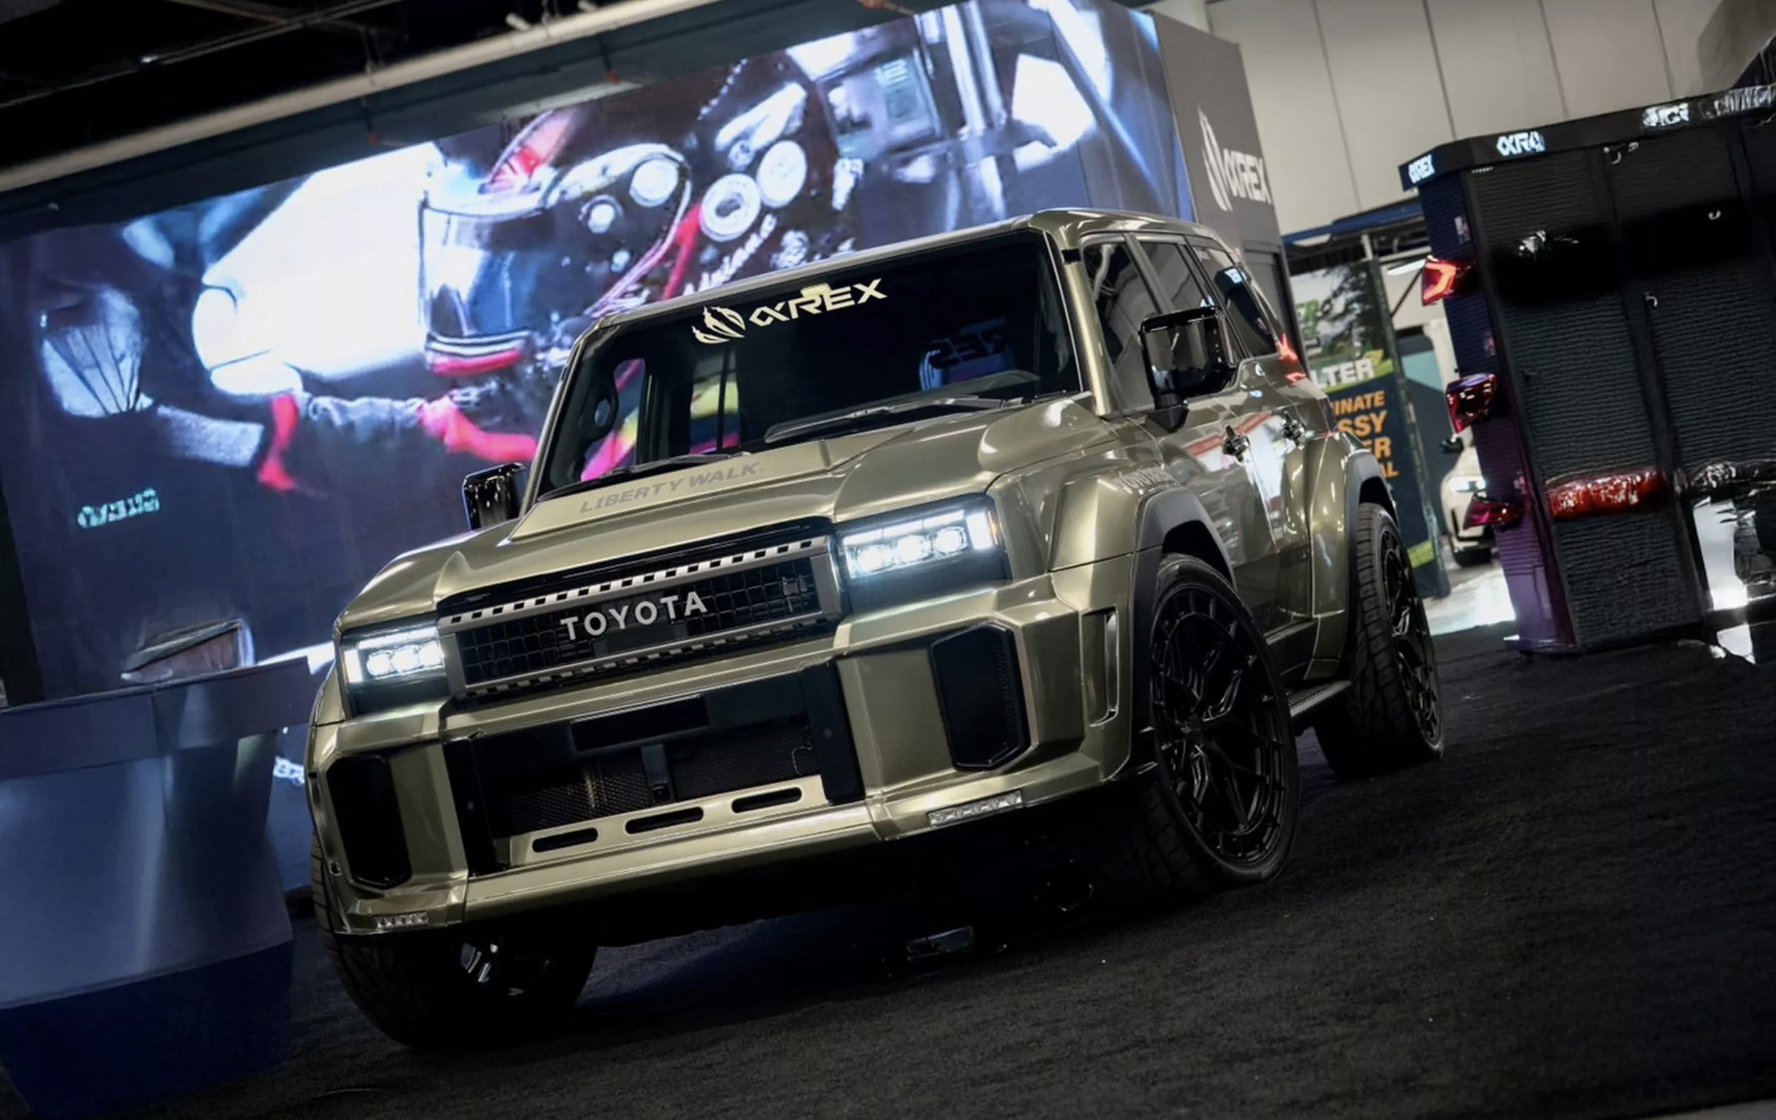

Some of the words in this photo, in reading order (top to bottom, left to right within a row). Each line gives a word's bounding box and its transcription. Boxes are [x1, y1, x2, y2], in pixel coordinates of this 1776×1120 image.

[1331, 390, 1385, 417] INATE
[579, 477, 684, 514] LIBERTY
[560, 591, 708, 640] TOYOTA
